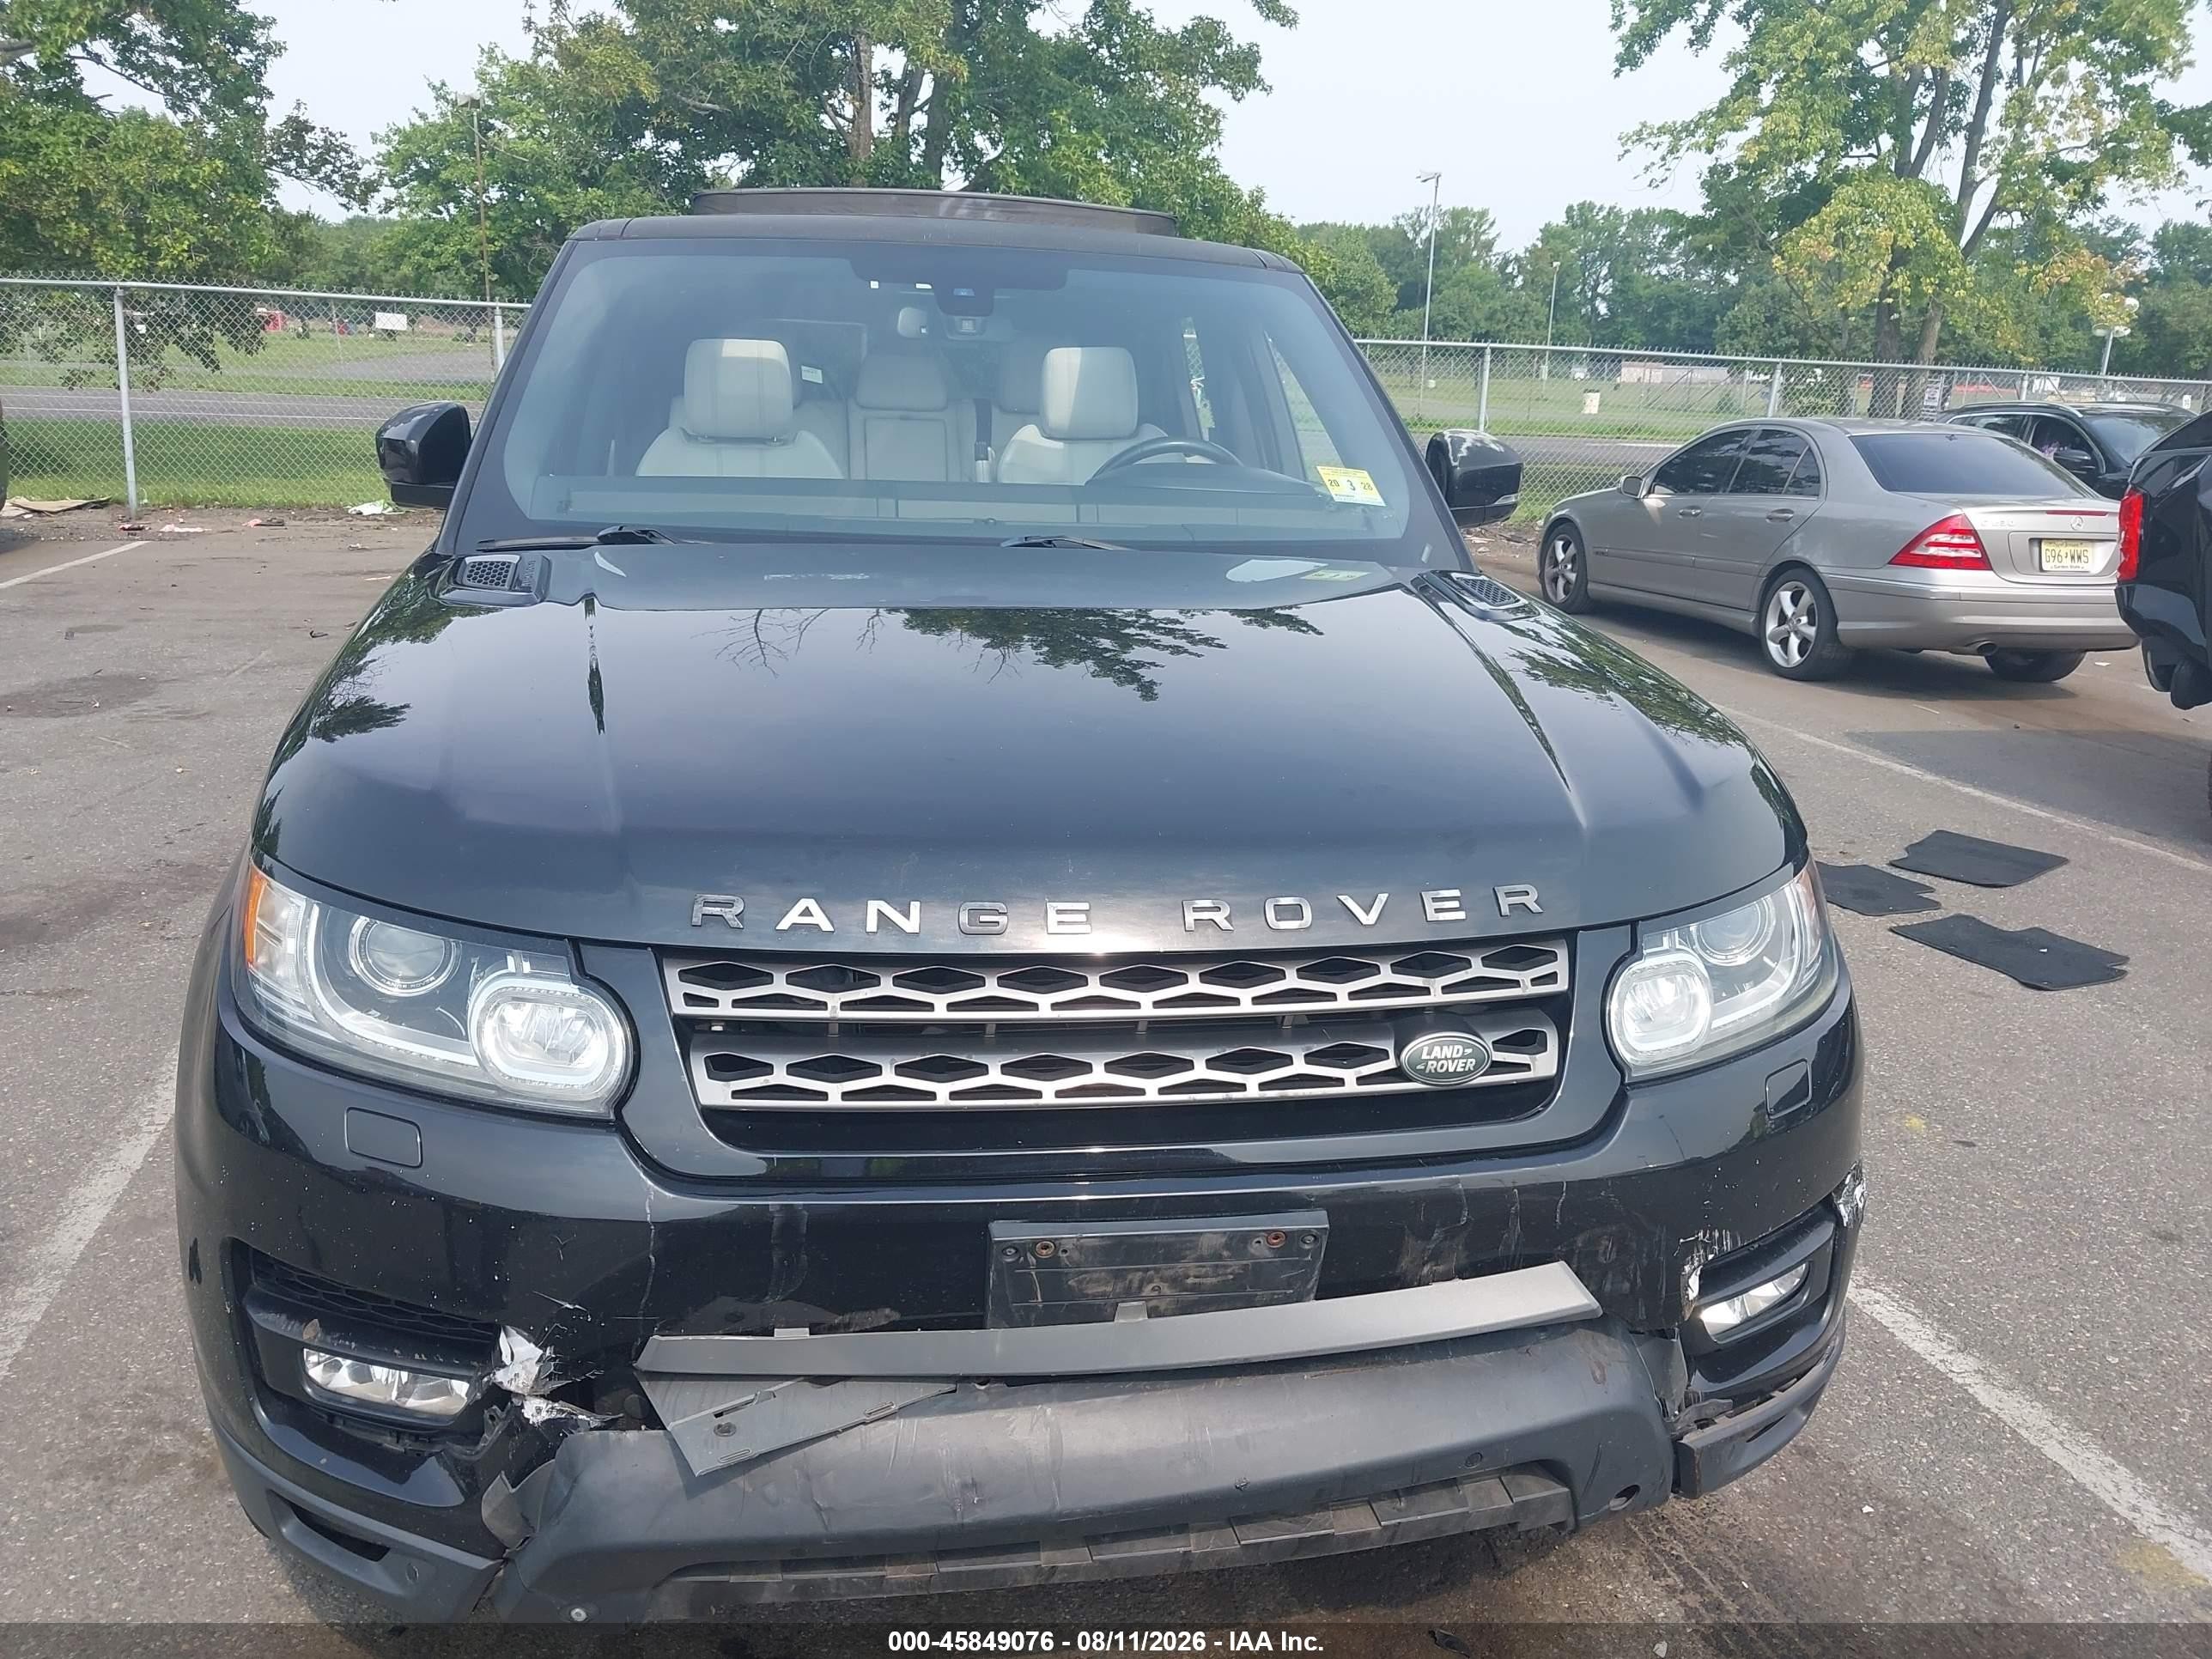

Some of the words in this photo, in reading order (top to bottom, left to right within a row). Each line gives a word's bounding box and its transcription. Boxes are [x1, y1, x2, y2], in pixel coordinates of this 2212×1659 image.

[1346, 479, 1356, 491] 3
[690, 893, 1093, 935] RANGE
[1182, 883, 1544, 932] ROVER
[1421, 1044, 1462, 1060] LAND
[1425, 1058, 1476, 1073] ROVER
